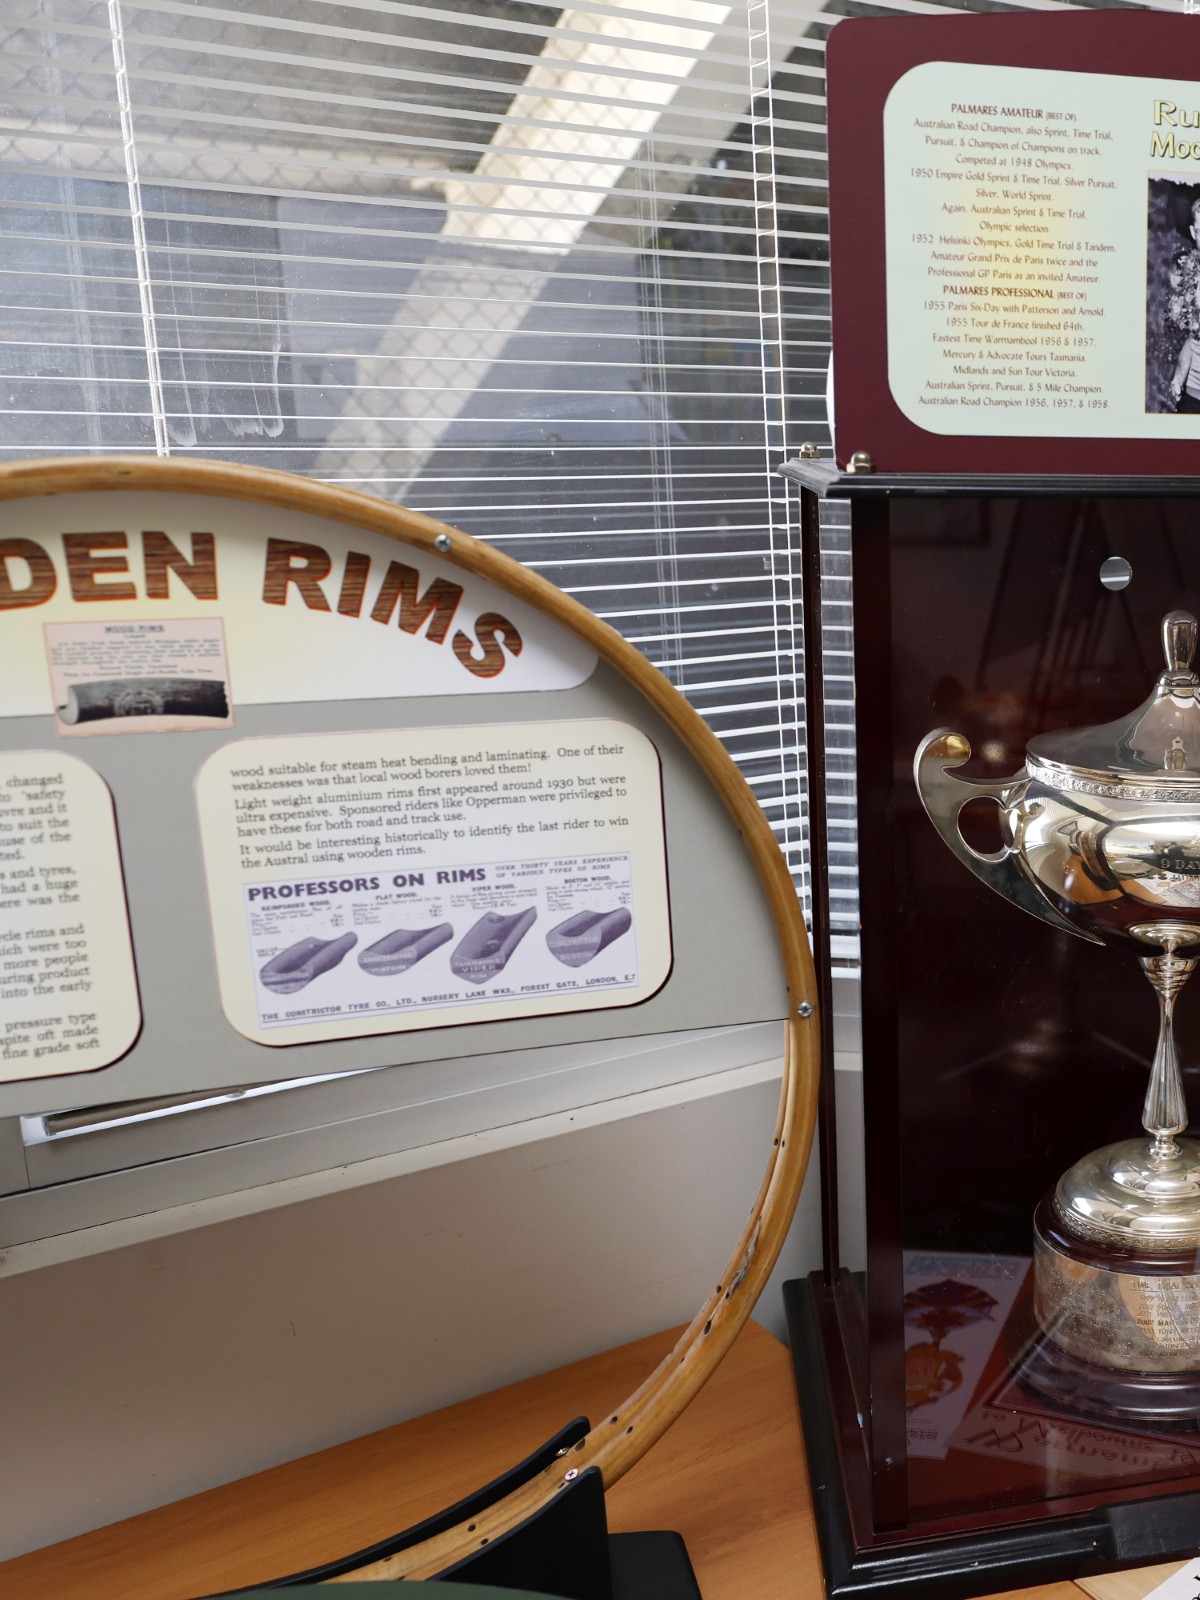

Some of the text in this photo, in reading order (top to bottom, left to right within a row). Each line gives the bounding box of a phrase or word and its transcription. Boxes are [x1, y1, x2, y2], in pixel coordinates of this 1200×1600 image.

[951, 103, 998, 115] PALMARES
[1000, 107, 1043, 118] AMATEUR
[942, 285, 988, 296] PALMARES
[991, 287, 1054, 298] PROFESSIONAL
[946, 317, 1085, 331] 1955 Tour de France finished 64th.
[262, 538, 523, 679] RIMS
[240, 845, 426, 869] the Austral using wooden rims.
[248, 868, 486, 900] PROFESSORS ON RIMS
[3, 952, 88, 970] more people
